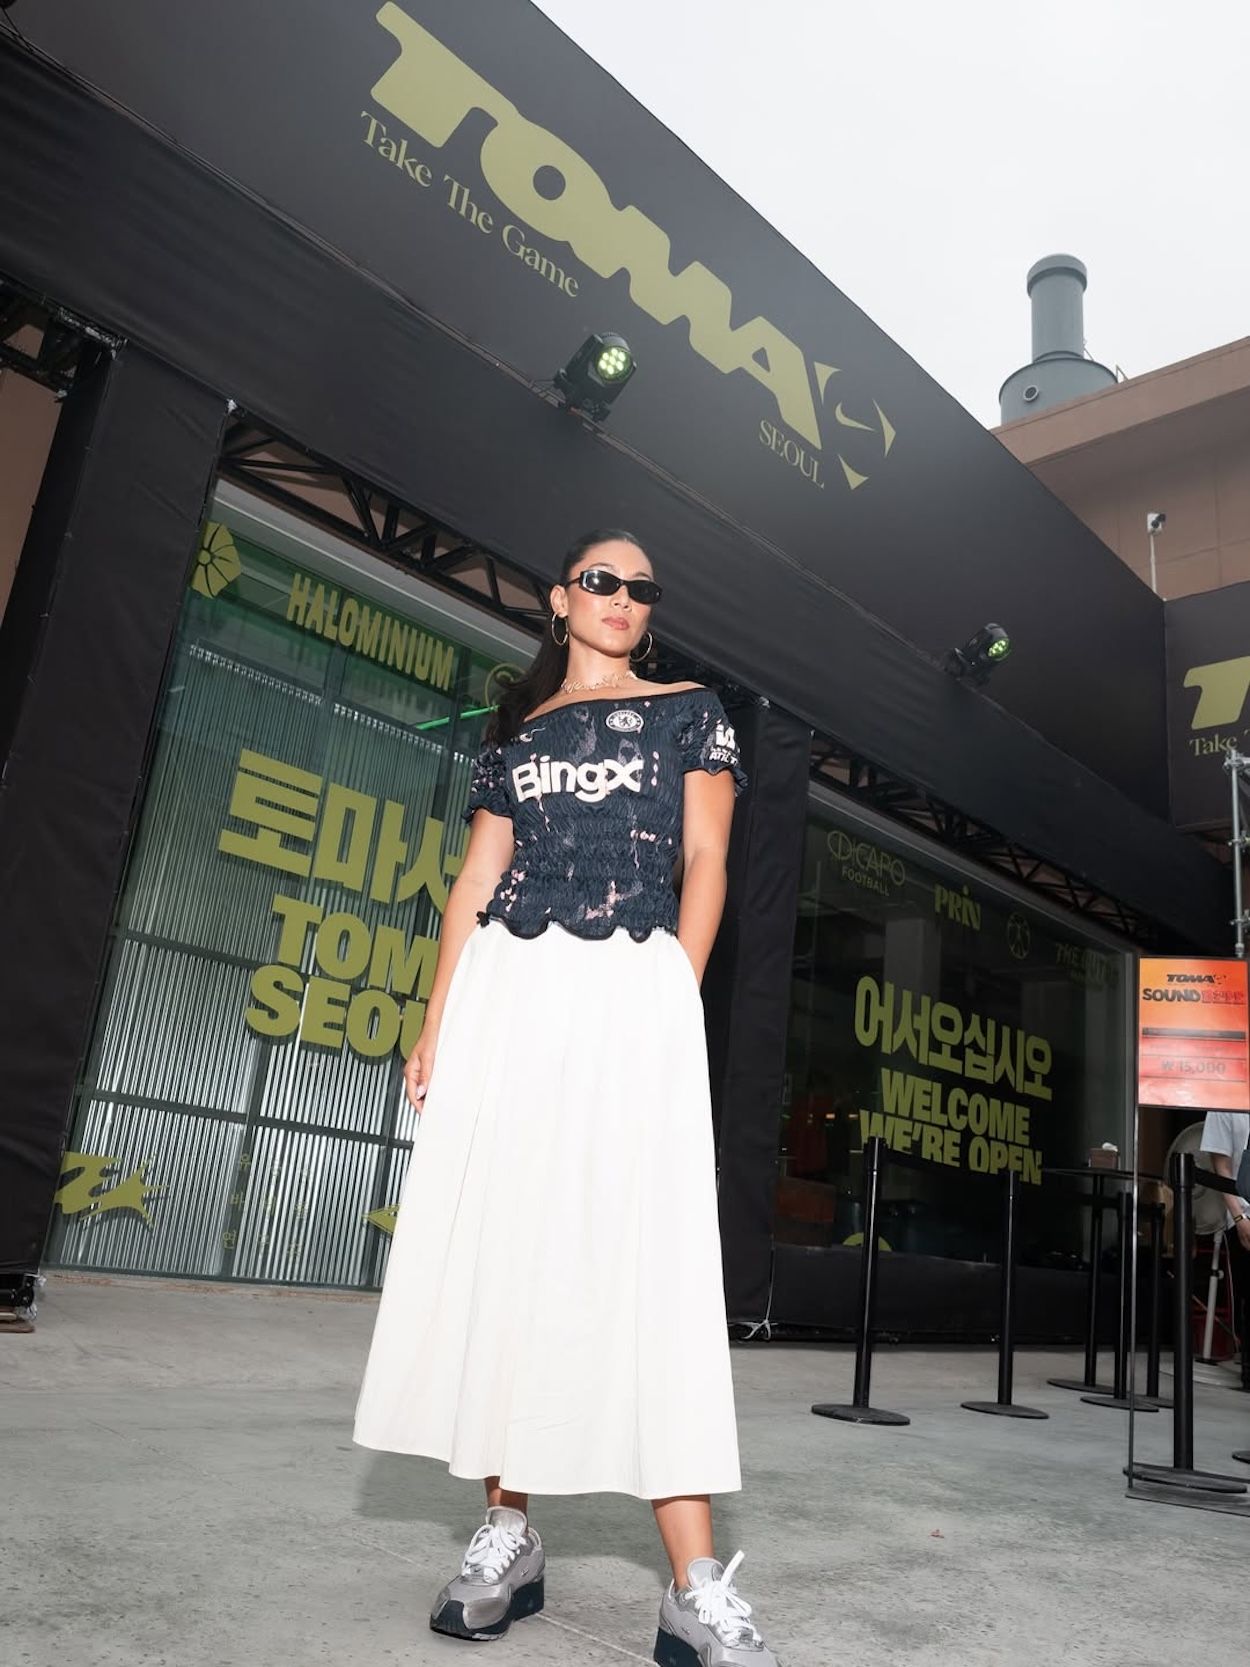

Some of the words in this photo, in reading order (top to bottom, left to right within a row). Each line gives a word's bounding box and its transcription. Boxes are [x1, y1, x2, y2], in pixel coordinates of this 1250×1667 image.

[360, 110, 433, 188] Take
[443, 174, 494, 234] The
[502, 224, 580, 298] Game
[370, 1, 822, 451] TOMA
[758, 419, 825, 489] SEOUL
[286, 572, 455, 691] HALOMINIUM
[512, 754, 644, 803] BingX
[1189, 733, 1238, 757] Take
[841, 866, 890, 897] FOOTBALL
[271, 894, 441, 1002] TOM
[855, 975, 1052, 1101] 어서오십시오
[881, 1067, 1030, 1145] WELCOME
[859, 1109, 961, 1167] WE'RE
[969, 1137, 1042, 1186] OPEN
